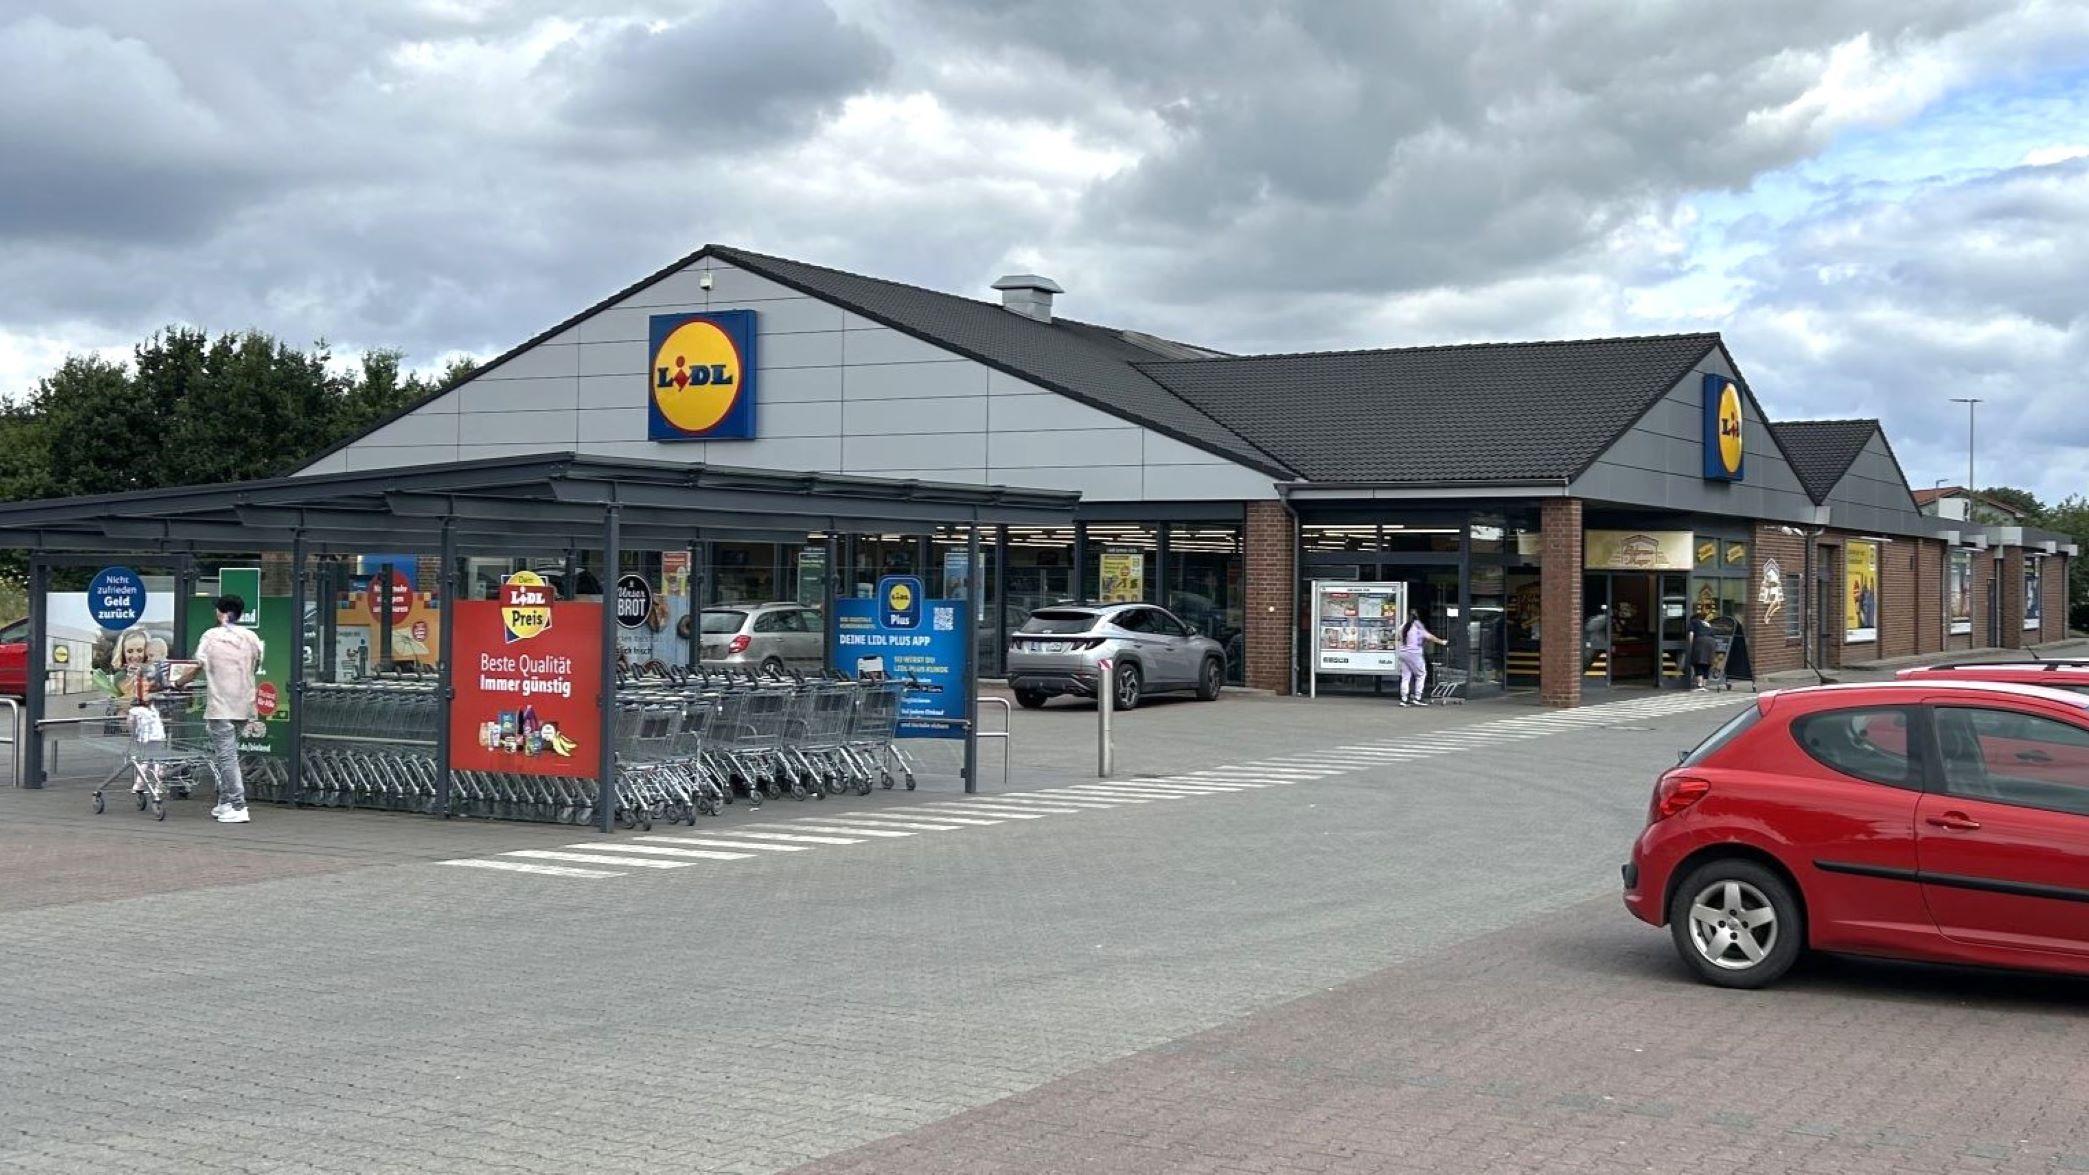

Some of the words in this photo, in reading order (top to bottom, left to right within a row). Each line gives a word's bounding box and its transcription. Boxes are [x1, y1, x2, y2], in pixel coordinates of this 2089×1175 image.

[657, 355, 733, 392] LIDL
[106, 575, 130, 584] Nicht
[97, 585, 137, 595] zufrieden
[510, 586, 546, 606] LIDL
[103, 596, 130, 606] Geld
[617, 599, 646, 616] BROT
[98, 608, 135, 619] zurück
[511, 609, 543, 627] Preis
[890, 614, 910, 625] Plus
[839, 634, 866, 645] DEINE
[868, 634, 888, 646] LIDL
[888, 635, 911, 646] PLUS
[912, 636, 931, 647] APP
[481, 652, 516, 672] Beste
[519, 654, 572, 677] Qualität
[480, 674, 521, 691] Immer
[522, 676, 571, 698] günstig
